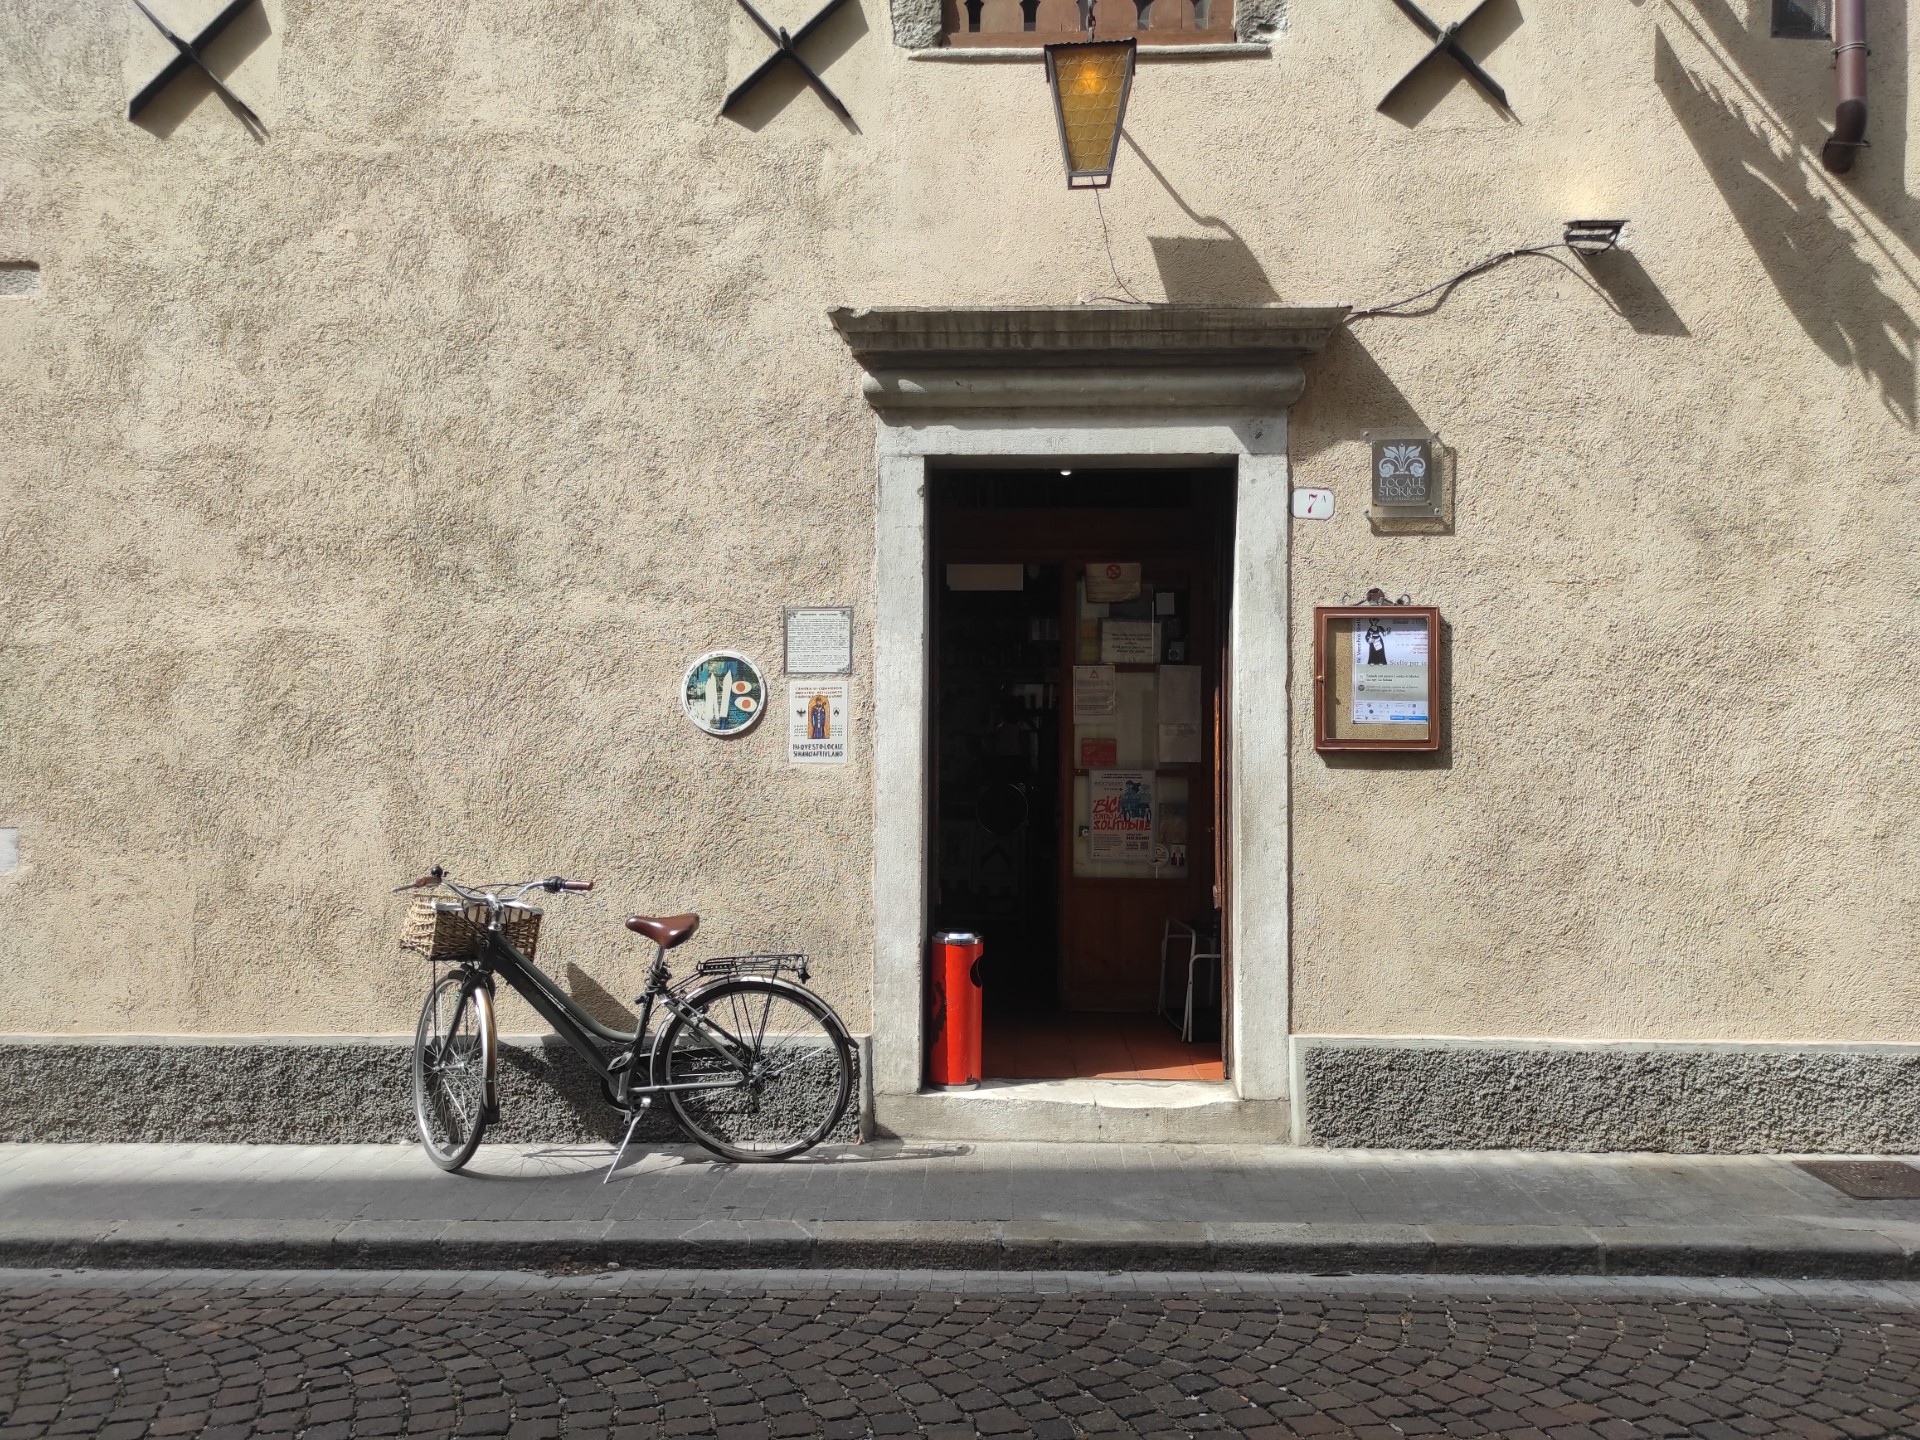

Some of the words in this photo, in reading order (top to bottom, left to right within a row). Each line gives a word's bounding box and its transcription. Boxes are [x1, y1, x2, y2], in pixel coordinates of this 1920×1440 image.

[1380, 478, 1424, 487] LOCALE
[1378, 487, 1426, 497] STORICO
[1307, 493, 1318, 514] 7
[1093, 819, 1152, 831] SOLITUDINE
